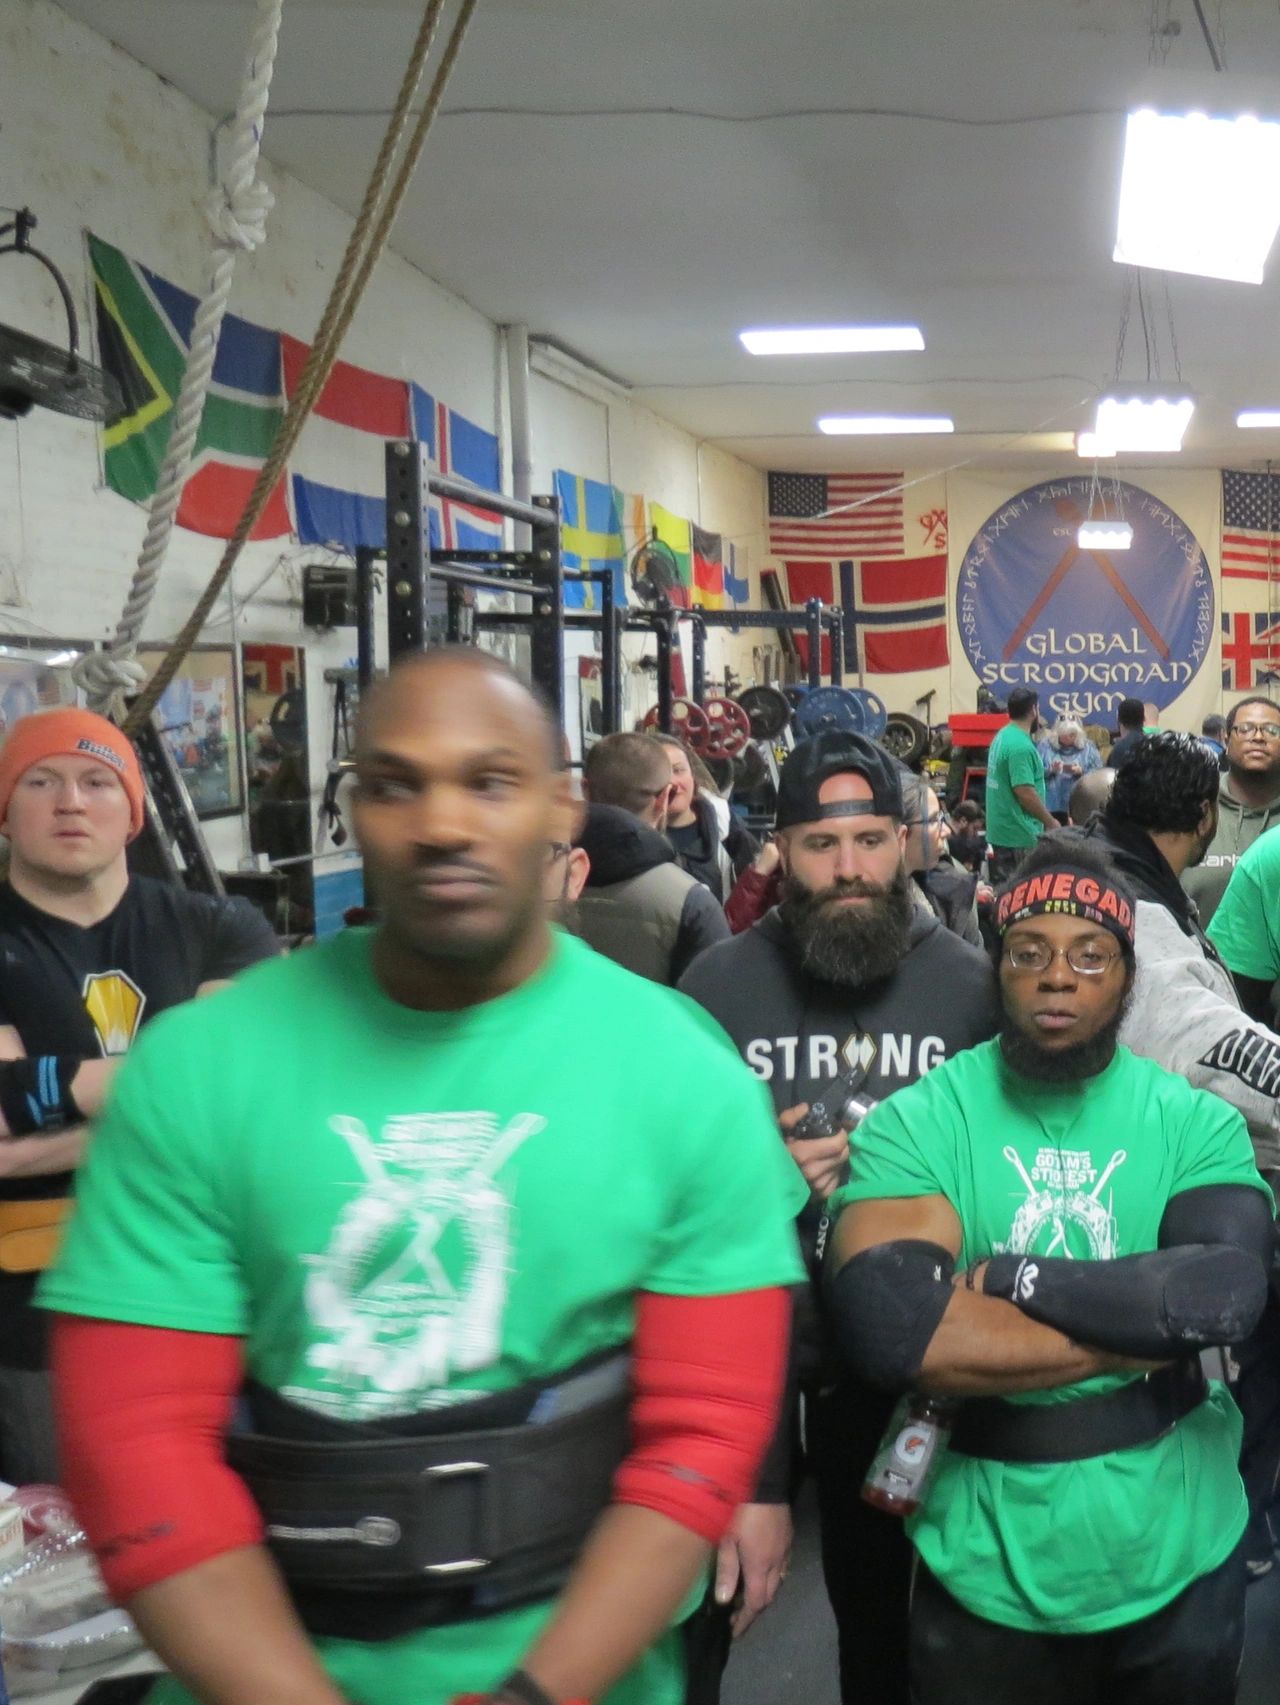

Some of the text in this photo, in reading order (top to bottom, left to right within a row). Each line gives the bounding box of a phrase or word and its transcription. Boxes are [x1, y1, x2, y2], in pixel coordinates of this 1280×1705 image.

[1025, 627, 1148, 658] GLOBAL
[982, 661, 1192, 686] STRONGMAN
[1049, 691, 1126, 715] GYM
[895, 1426, 930, 1464] G
